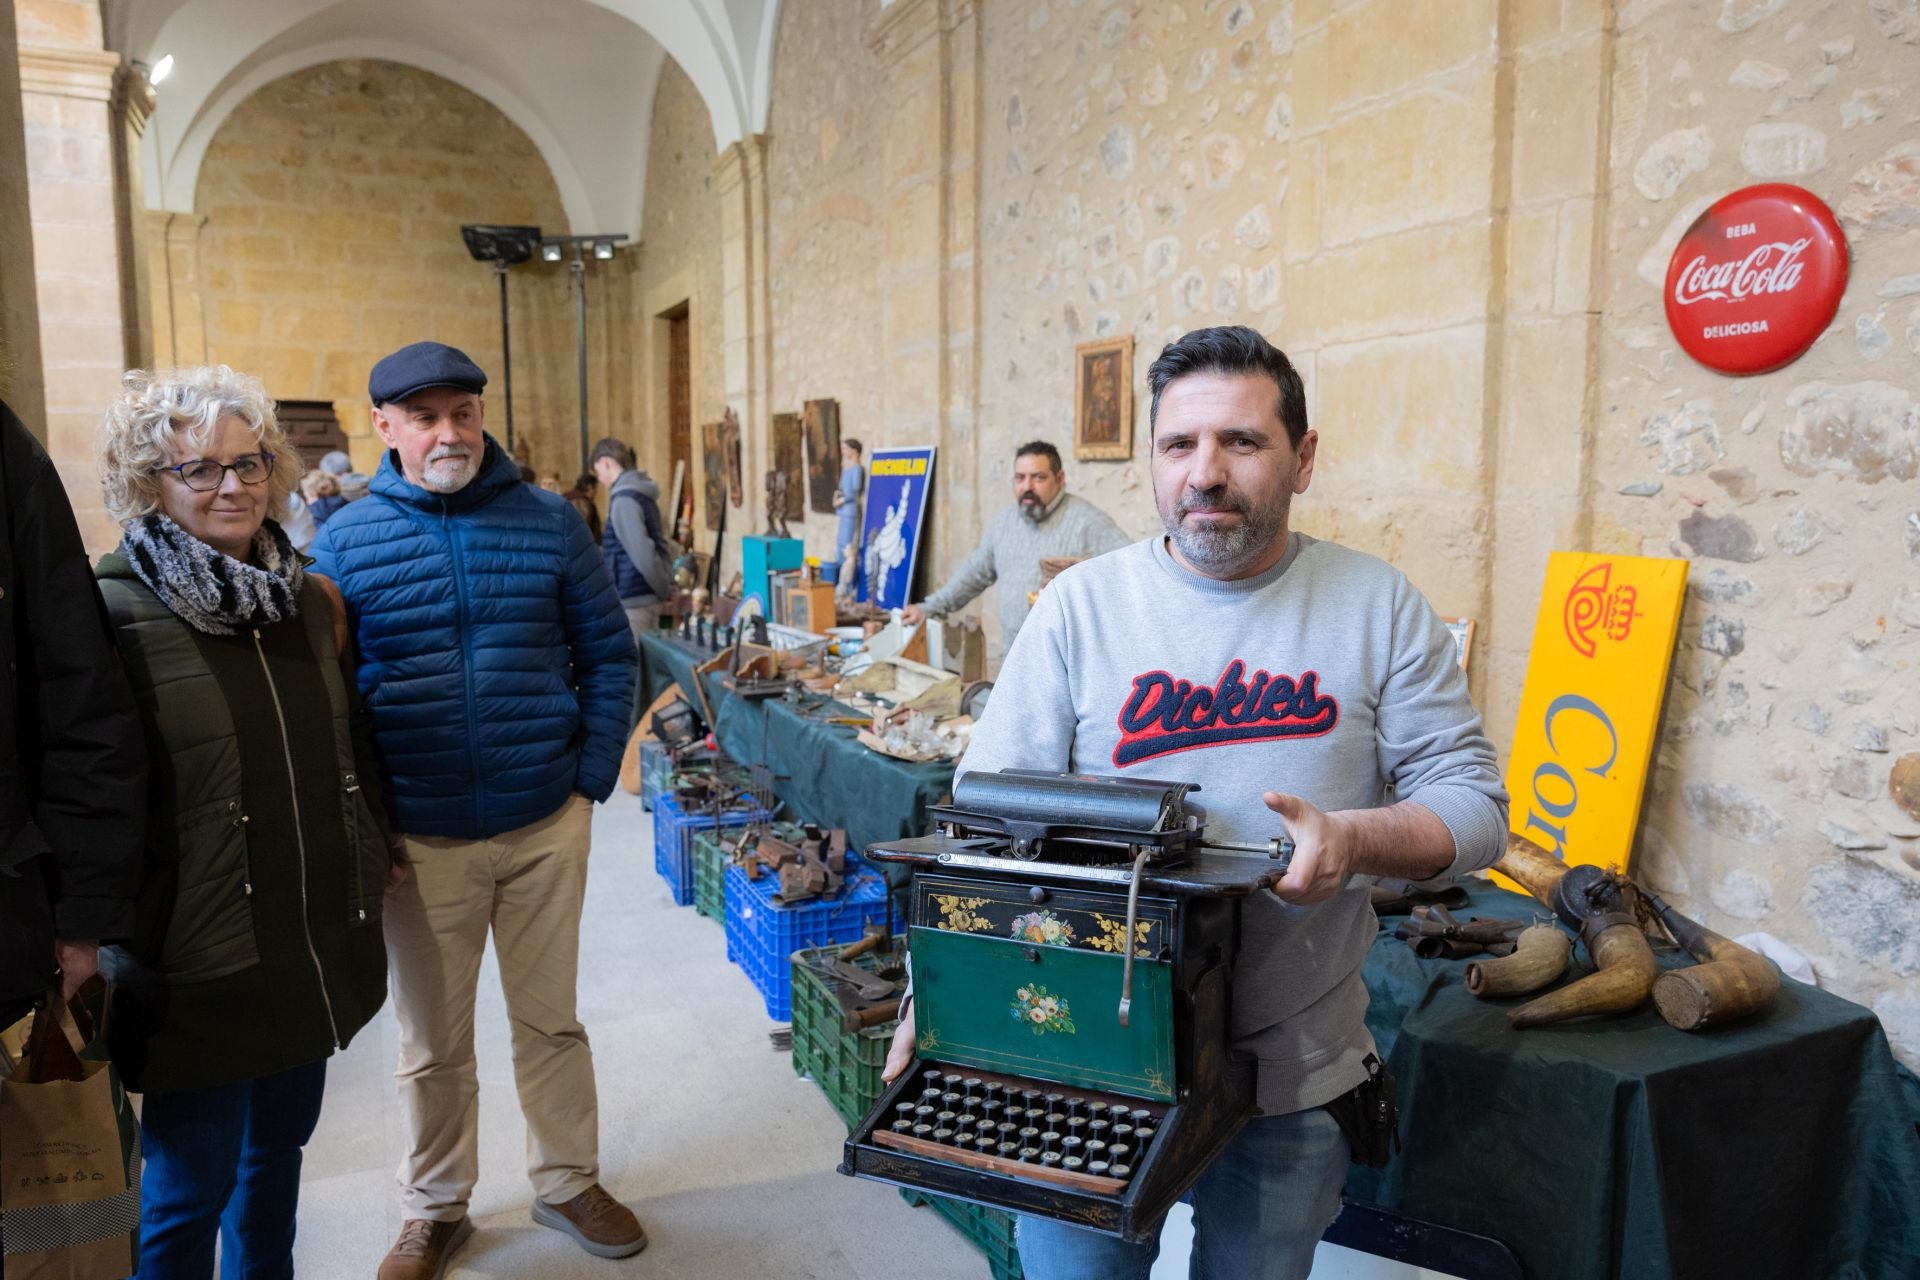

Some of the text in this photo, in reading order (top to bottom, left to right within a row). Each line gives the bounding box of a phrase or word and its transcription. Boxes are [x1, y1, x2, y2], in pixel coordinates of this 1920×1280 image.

[1726, 223, 1756, 239] BEBA
[1703, 320, 1769, 339] DELICIOSA
[1114, 659, 1340, 767] Dickies
